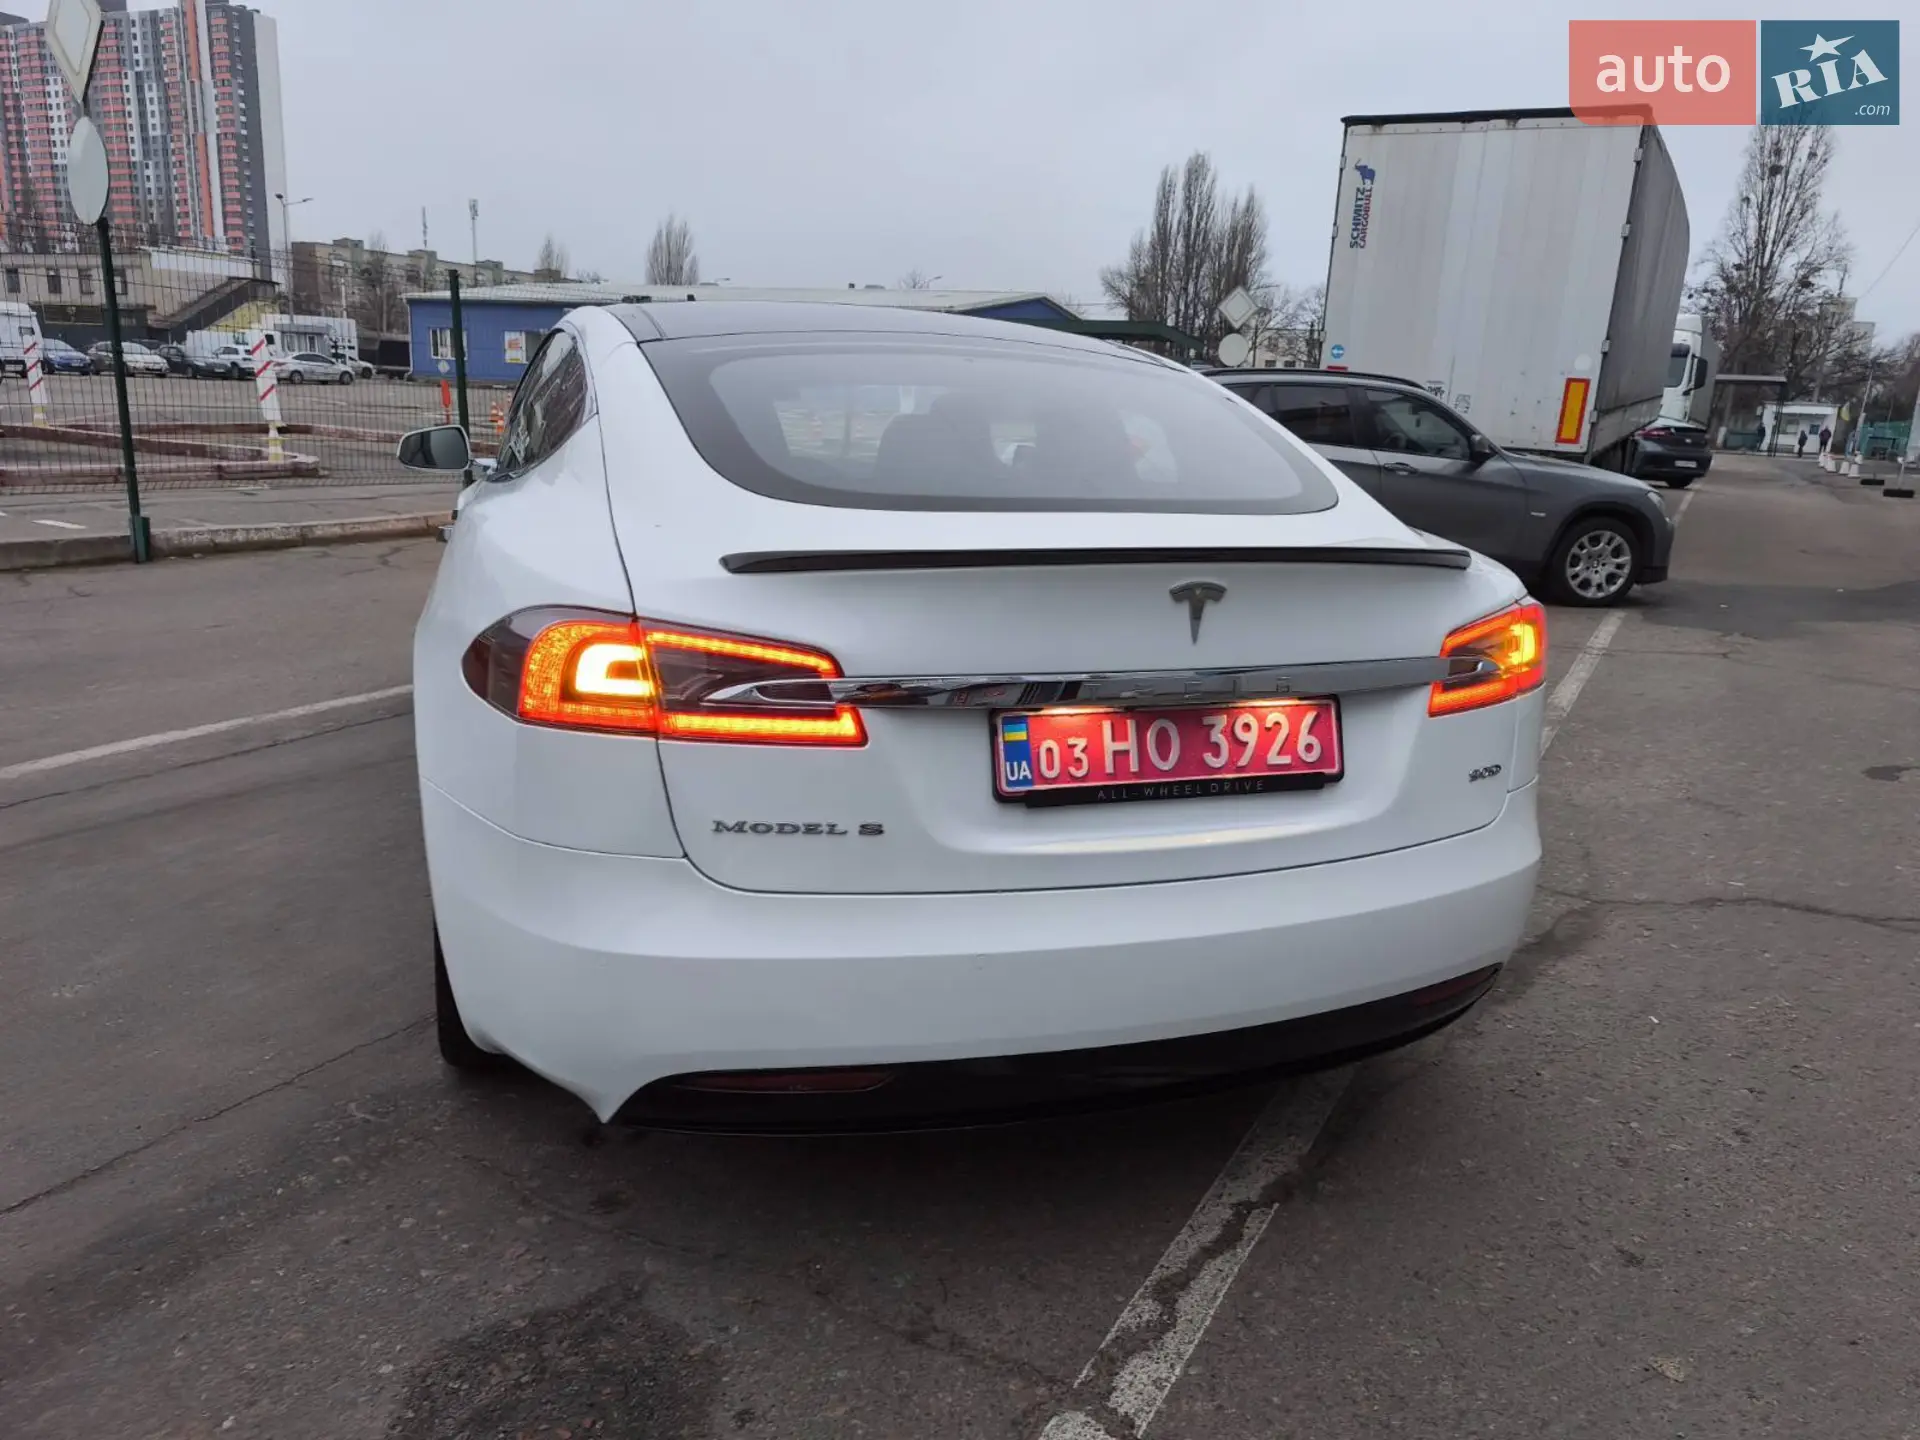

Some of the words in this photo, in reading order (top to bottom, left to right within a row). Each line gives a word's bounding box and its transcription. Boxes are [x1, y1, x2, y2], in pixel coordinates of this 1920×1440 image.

[1349, 187, 1366, 249] SCHMITZ
[1358, 186, 1373, 249] CARGOBULL
[1038, 737, 1088, 779] 03
[1102, 717, 1181, 775] HO
[1202, 711, 1322, 769] 3926
[1006, 760, 1032, 782] UA
[1209, 779, 1266, 794] DRIVE
[712, 820, 848, 836] MODEL
[858, 822, 885, 836] S
